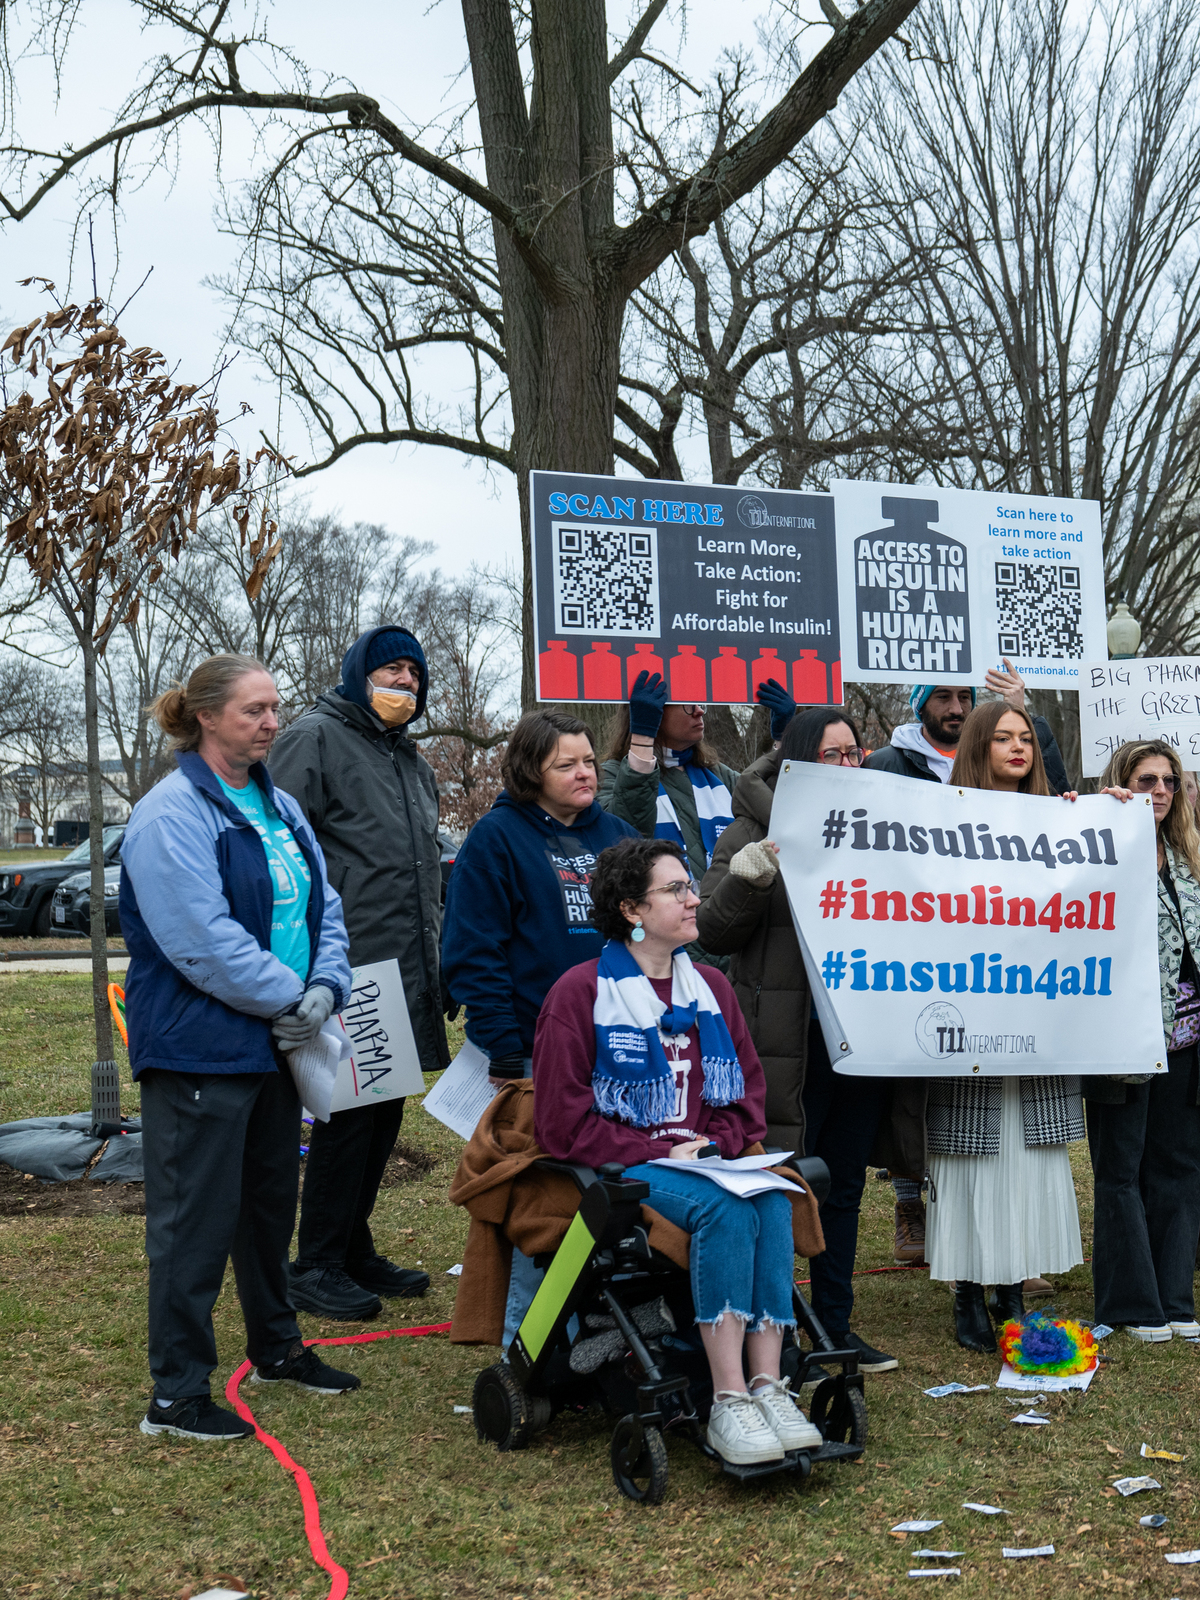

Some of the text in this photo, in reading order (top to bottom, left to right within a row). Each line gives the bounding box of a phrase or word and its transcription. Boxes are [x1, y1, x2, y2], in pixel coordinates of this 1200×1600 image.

[549, 492, 724, 527] SCAN HERE
[996, 506, 1074, 523] Scan here to
[988, 524, 1083, 543] learn more and
[697, 536, 802, 560] Learn More,
[858, 539, 964, 566] ACCESS TO
[1002, 544, 1071, 560] take action
[694, 562, 801, 583] Take Action:
[858, 560, 965, 592] INSULIN
[716, 589, 788, 610] Fight for
[889, 590, 938, 613] IS A
[671, 614, 831, 635] Affordable Insulin!
[862, 611, 965, 641] HUMAN
[868, 639, 963, 672] RIGHT
[1090, 667, 1130, 688] BIG
[1088, 700, 1126, 718] THE
[822, 808, 1119, 869] #insulin4all
[819, 878, 1116, 933] #insulin4all
[821, 948, 1113, 1000] #insulin4all
[345, 980, 392, 1089] PHARMA
